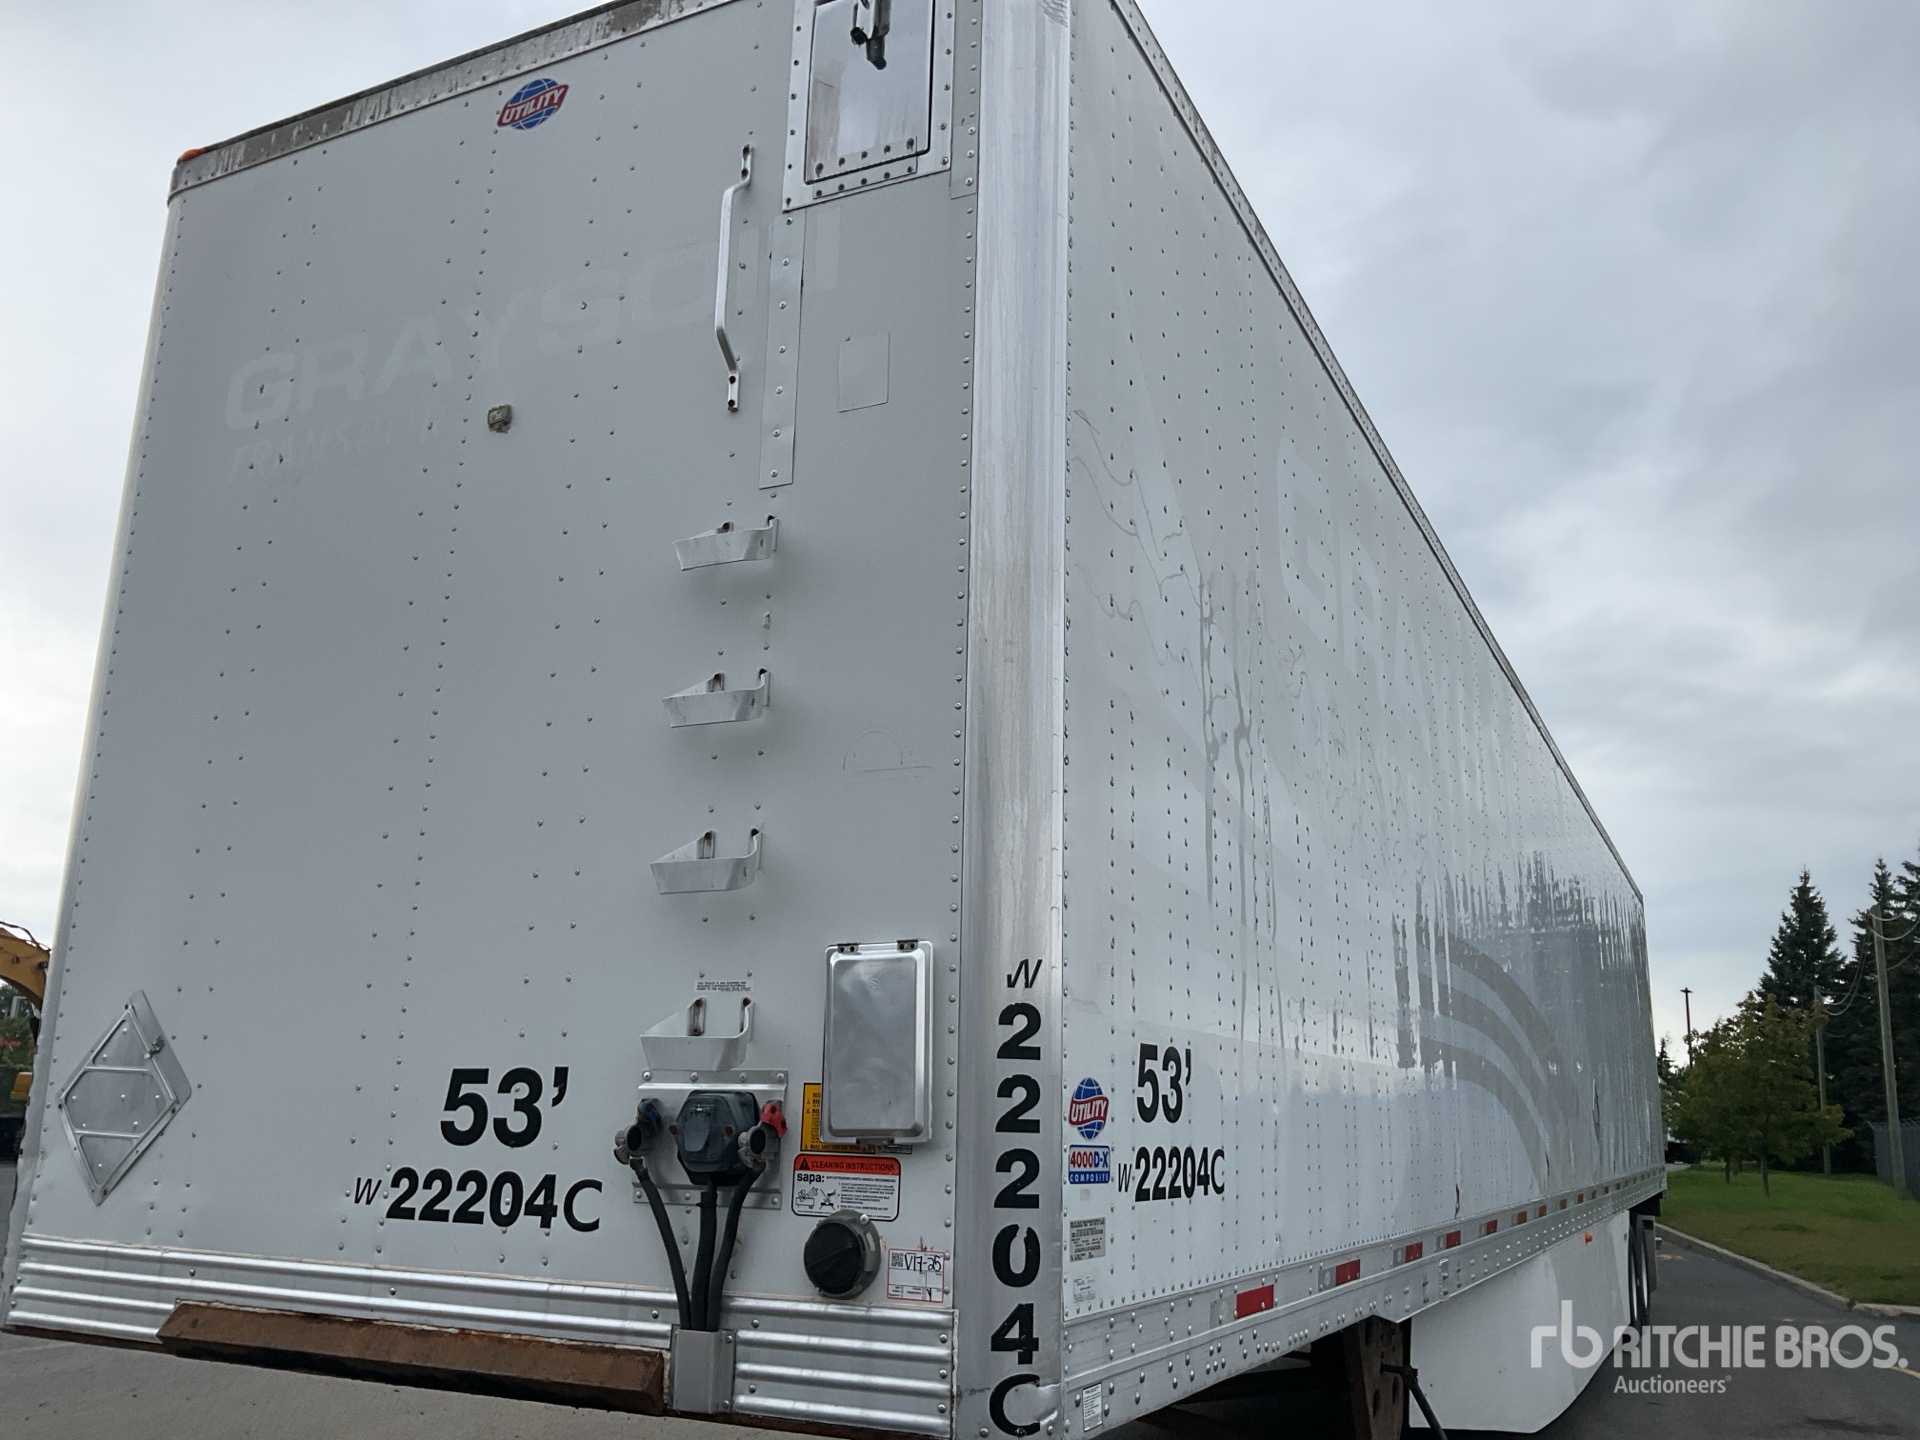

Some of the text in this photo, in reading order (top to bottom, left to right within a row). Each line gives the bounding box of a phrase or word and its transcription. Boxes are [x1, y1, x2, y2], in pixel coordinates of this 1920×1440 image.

[500, 87, 565, 124] UTILITY
[1136, 1043, 1192, 1124] 53'
[440, 1066, 569, 1148] 53'
[1071, 1100, 1107, 1122] UTILITY
[811, 1161, 895, 1172] CLEANING INSTRUCTIONS
[1070, 1151, 1109, 1169] 4000D-X
[797, 1173, 825, 1184] sapa:
[1069, 1173, 1109, 1183] COMPOSITE
